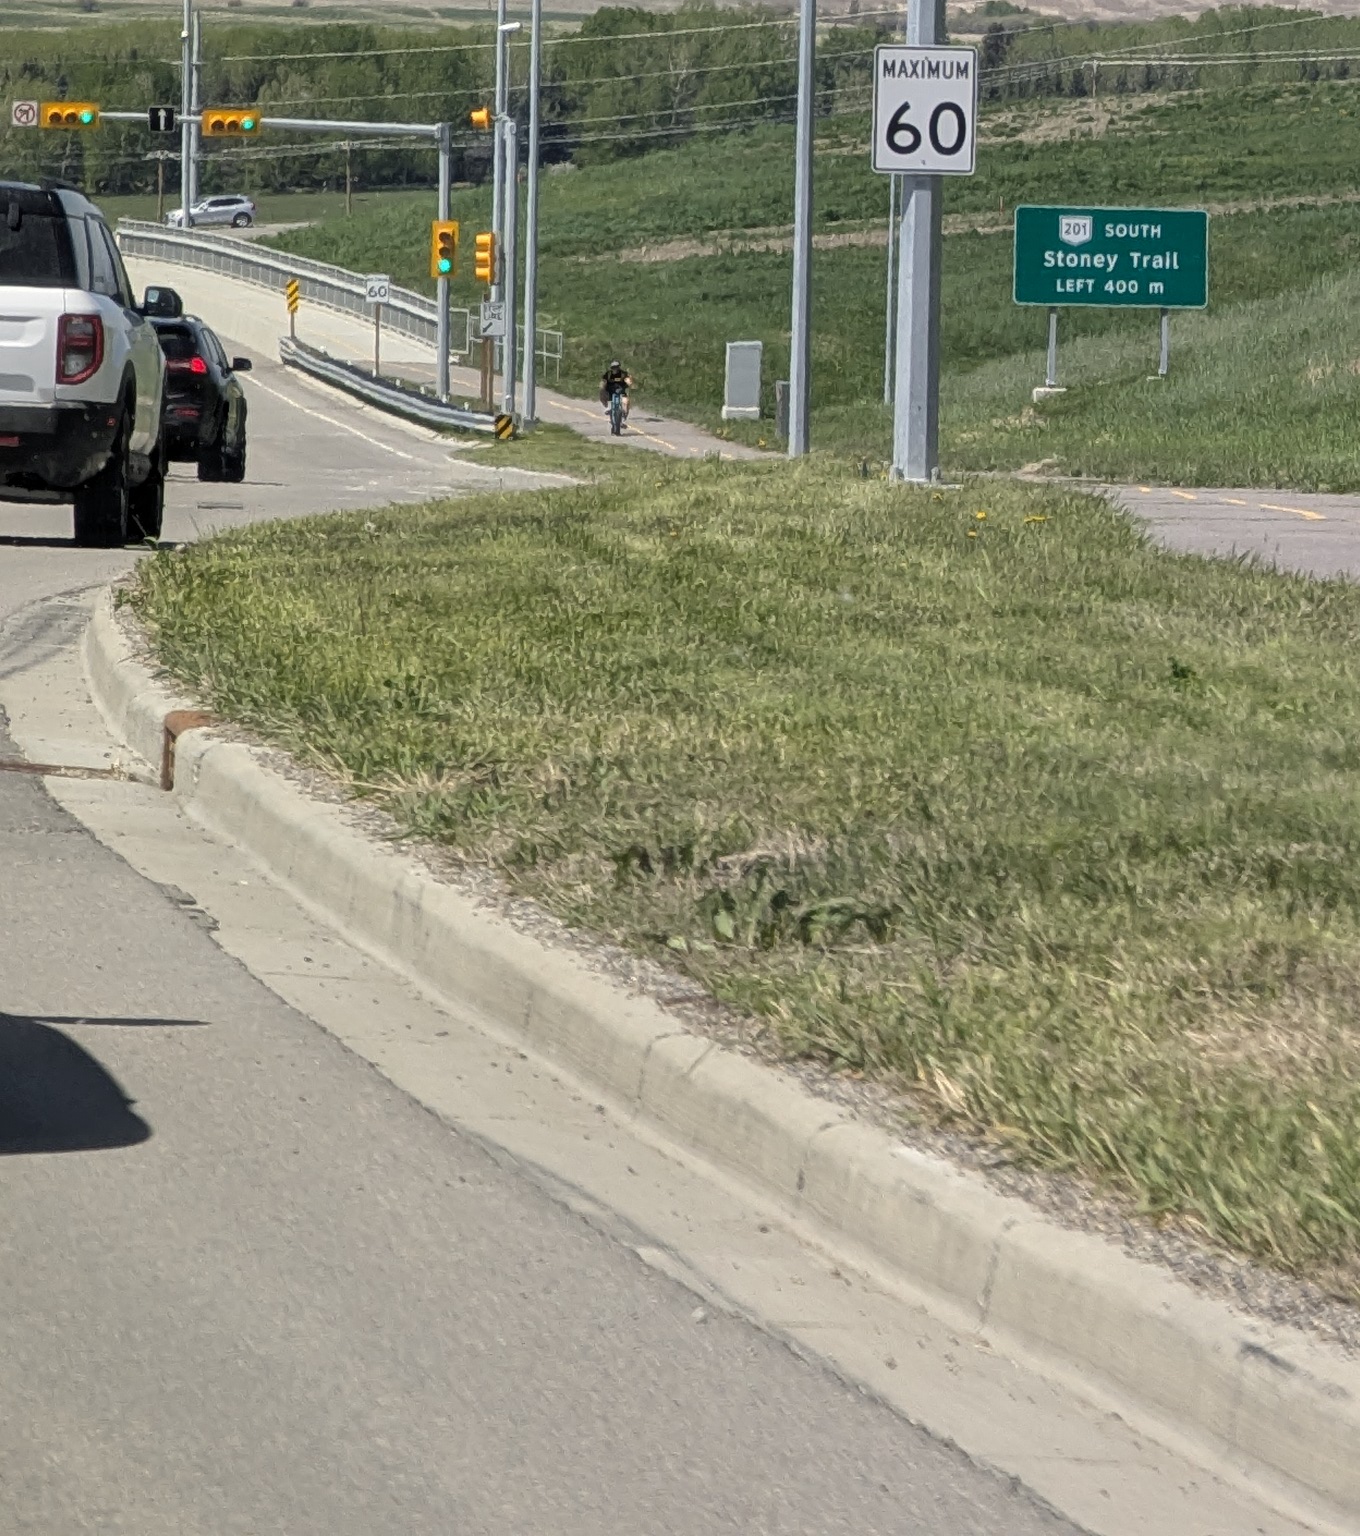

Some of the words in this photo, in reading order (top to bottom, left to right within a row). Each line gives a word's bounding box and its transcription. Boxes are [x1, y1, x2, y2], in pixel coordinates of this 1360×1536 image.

[883, 59, 969, 79] MAXIMUM
[886, 101, 966, 156] 60
[1064, 223, 1087, 236] 201
[1105, 223, 1162, 239] SOUTH
[1043, 250, 1119, 273] Stoney
[1129, 251, 1180, 270] Trail
[369, 285, 387, 298] 60
[1056, 279, 1095, 293] LEFT
[1104, 279, 1139, 294] 400
[1148, 282, 1164, 294] m
